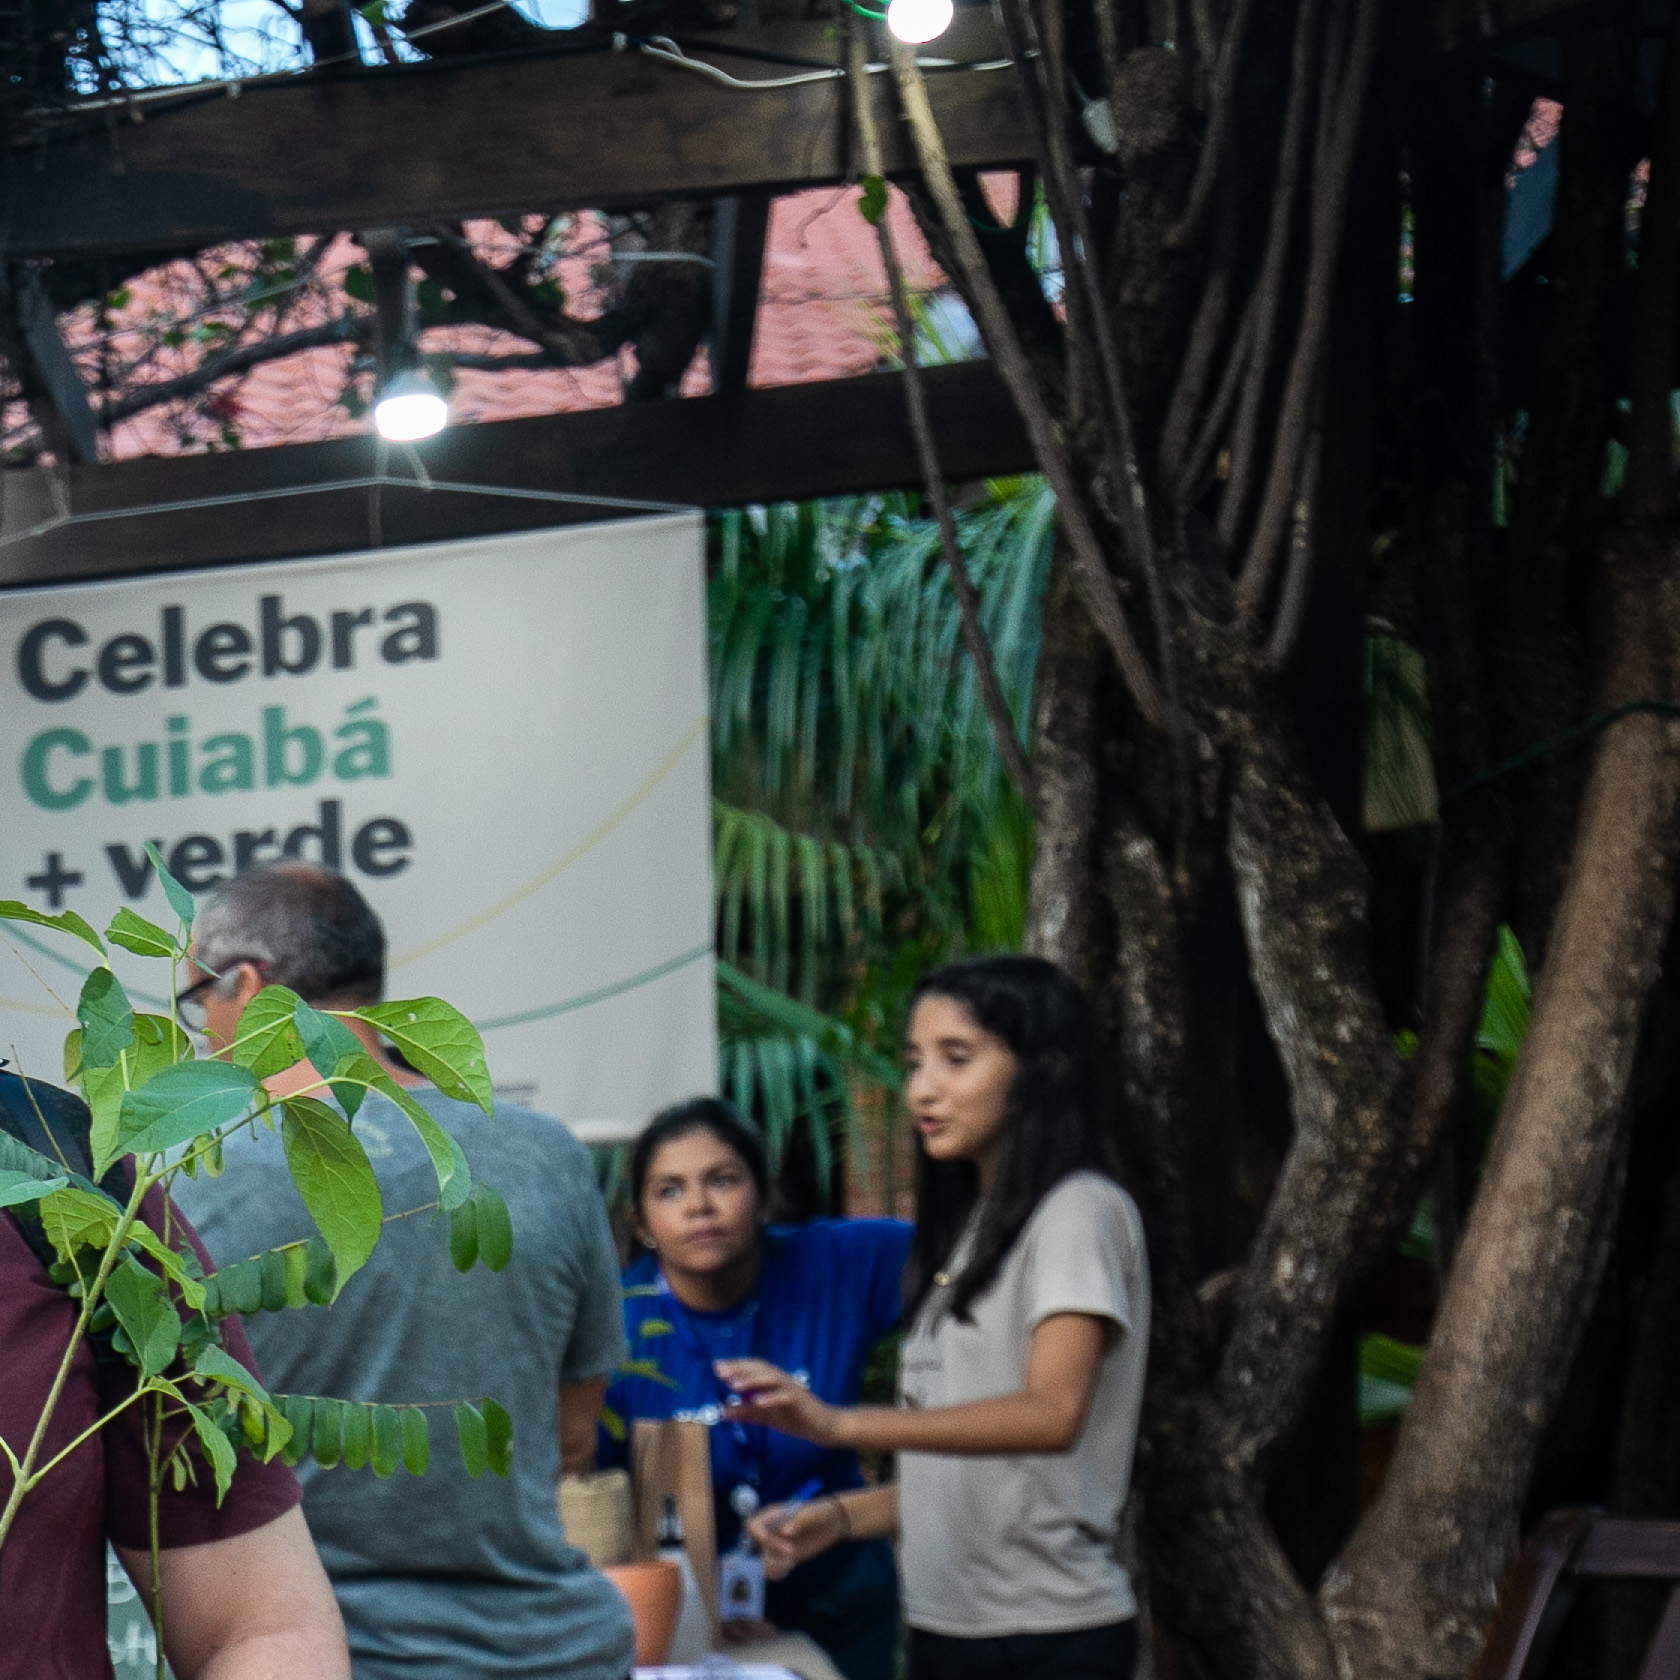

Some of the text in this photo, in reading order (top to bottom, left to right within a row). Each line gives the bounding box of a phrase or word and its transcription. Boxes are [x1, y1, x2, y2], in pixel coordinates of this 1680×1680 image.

[17, 594, 439, 702] Celebra
[20, 695, 392, 812] Cuiabá
[105, 799, 412, 900] verde
